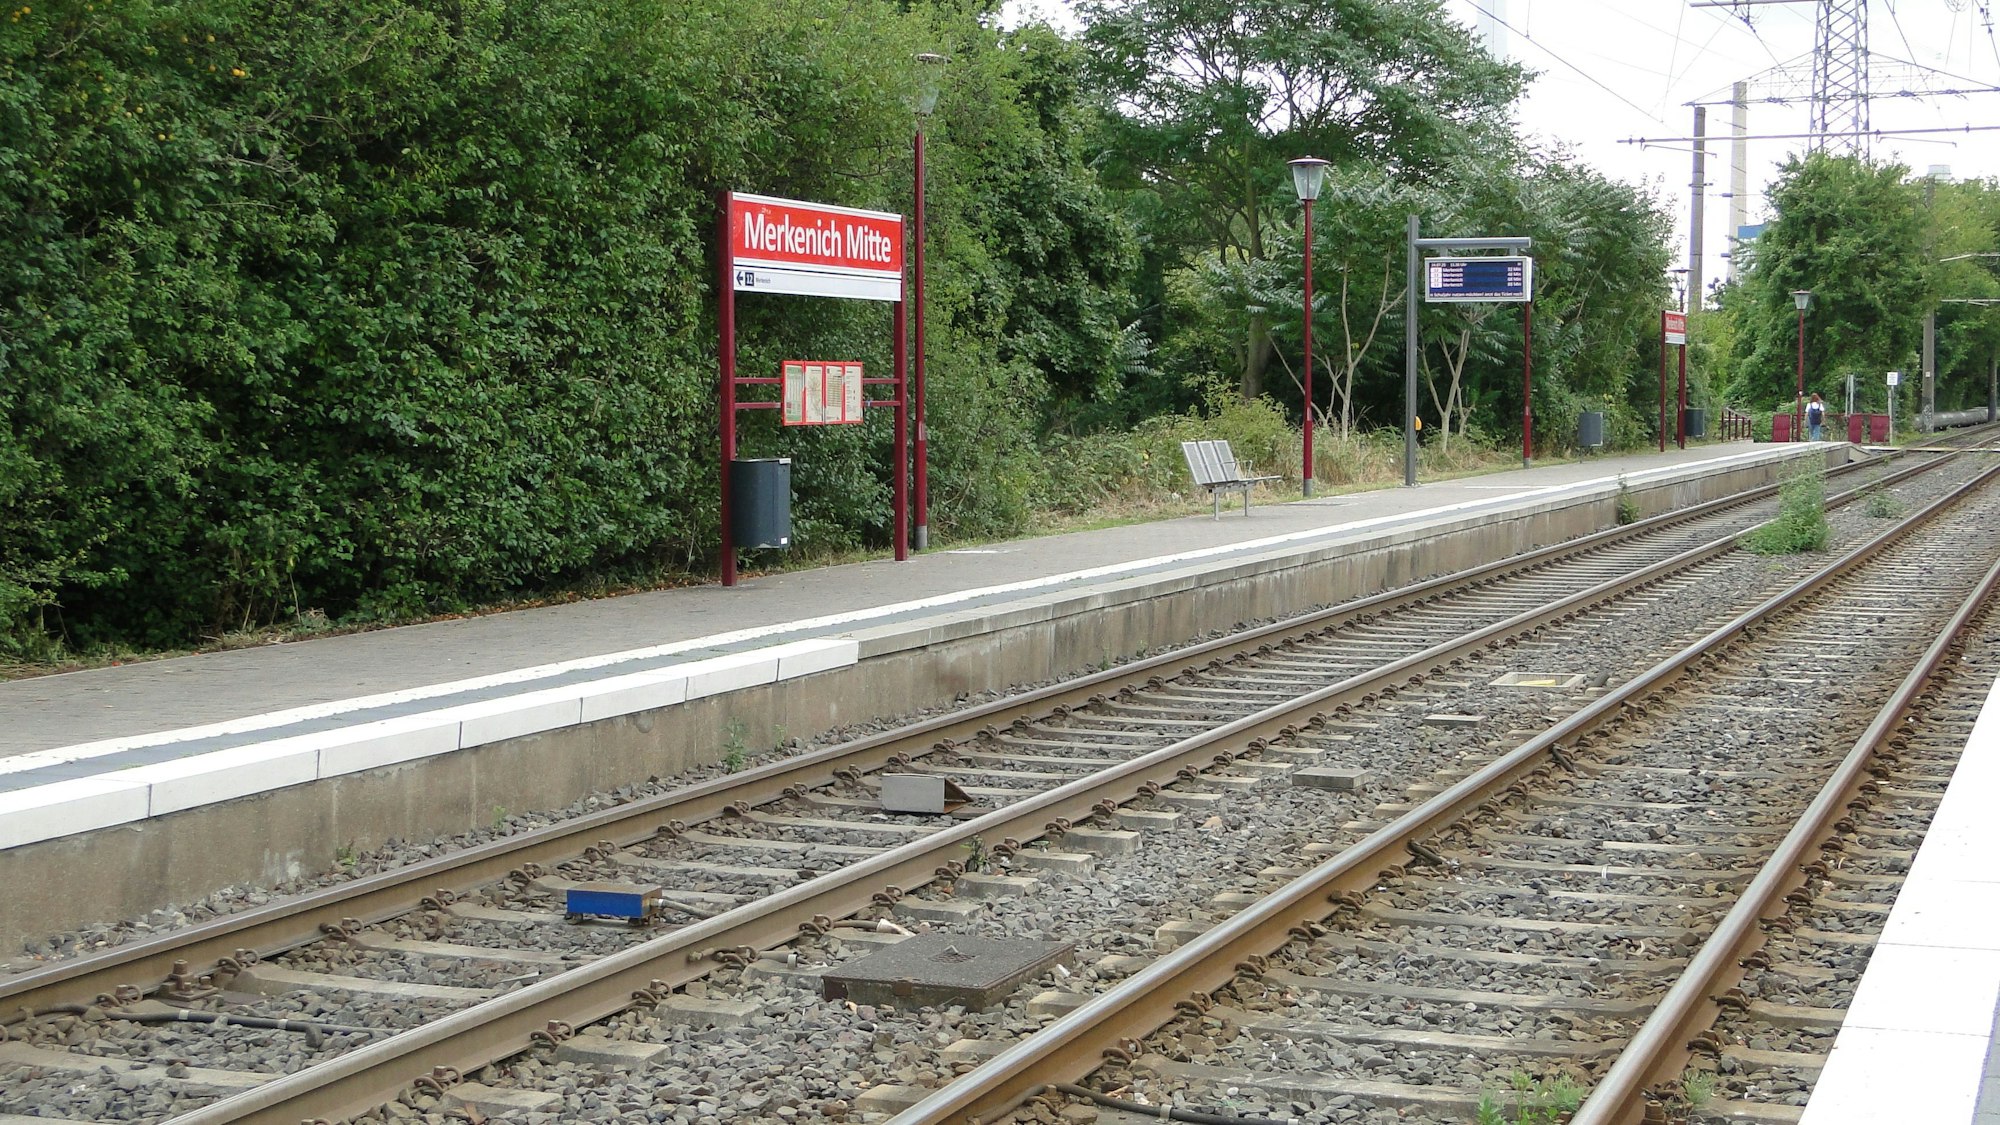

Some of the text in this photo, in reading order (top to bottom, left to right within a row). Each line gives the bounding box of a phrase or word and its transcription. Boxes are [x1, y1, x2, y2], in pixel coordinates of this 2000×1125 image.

[744, 211, 891, 263] Merkenich Mitte
[746, 273, 754, 285] 12
